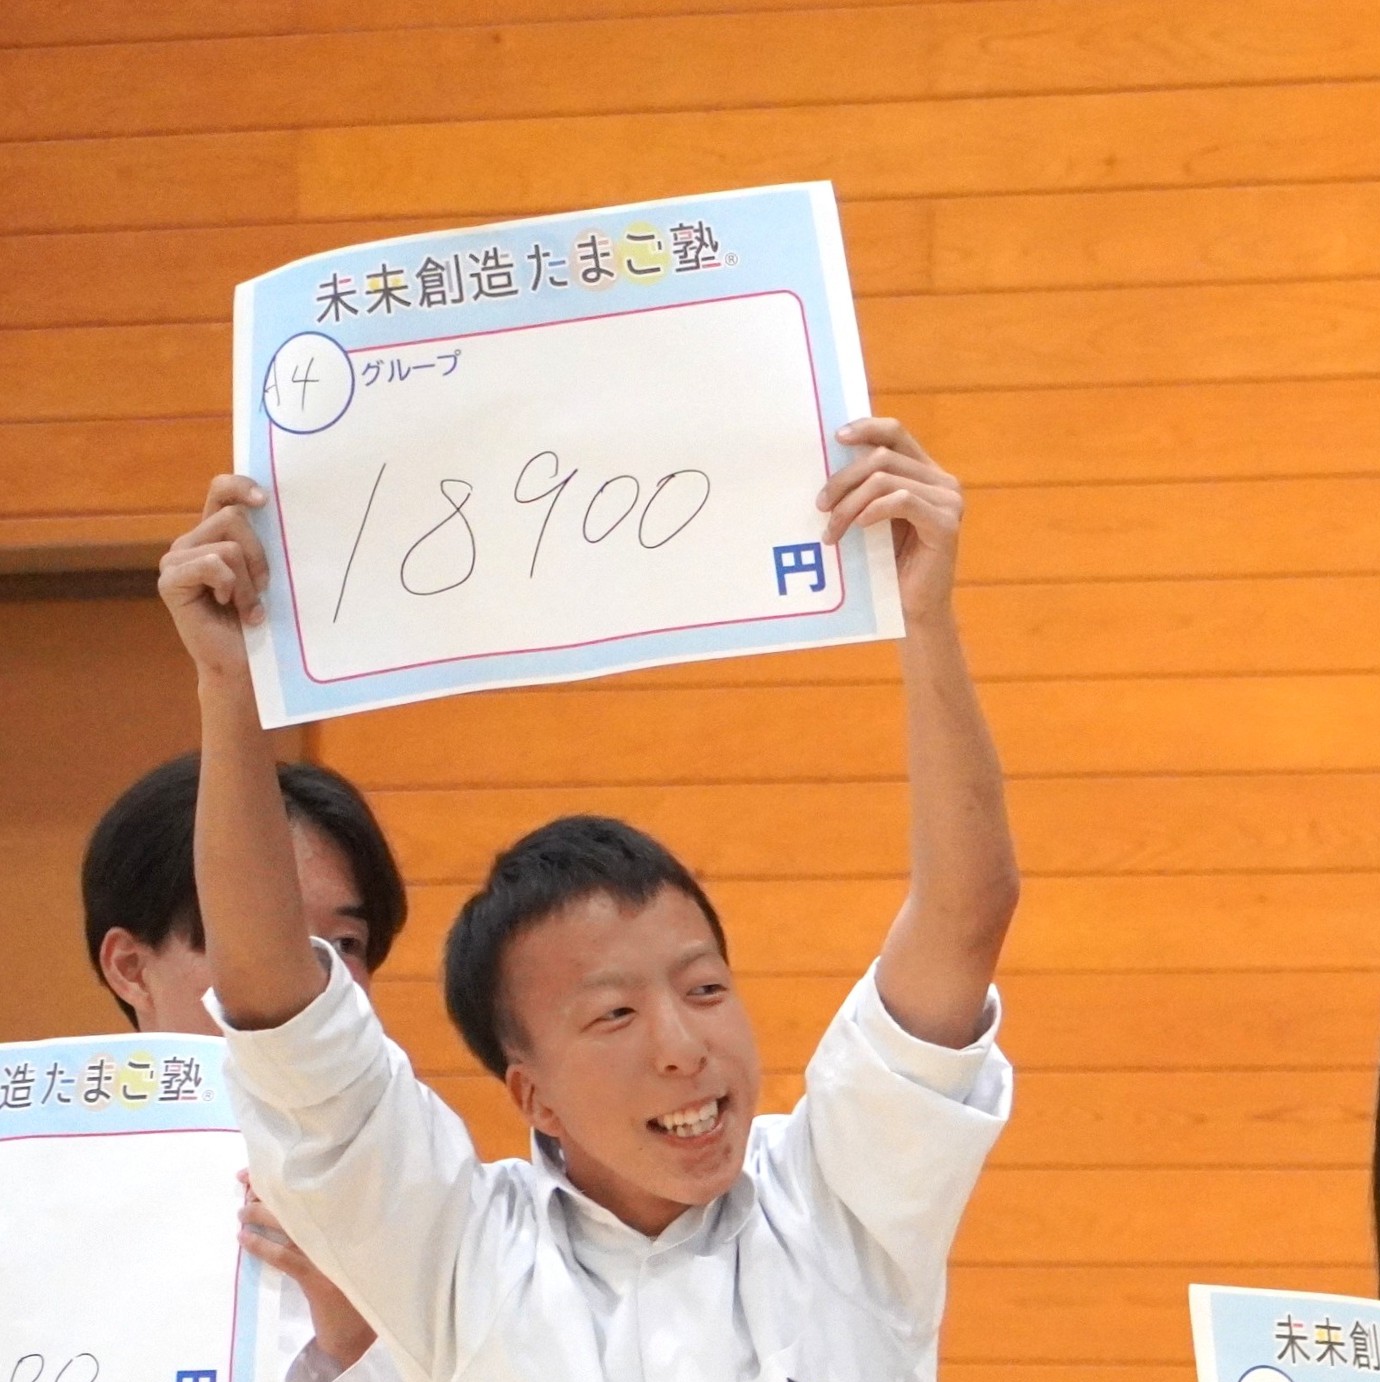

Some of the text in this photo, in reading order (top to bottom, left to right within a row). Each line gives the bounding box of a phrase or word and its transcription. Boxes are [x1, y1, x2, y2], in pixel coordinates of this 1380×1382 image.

[361, 349, 462, 387] グループ
[333, 451, 827, 623] 18900 円
